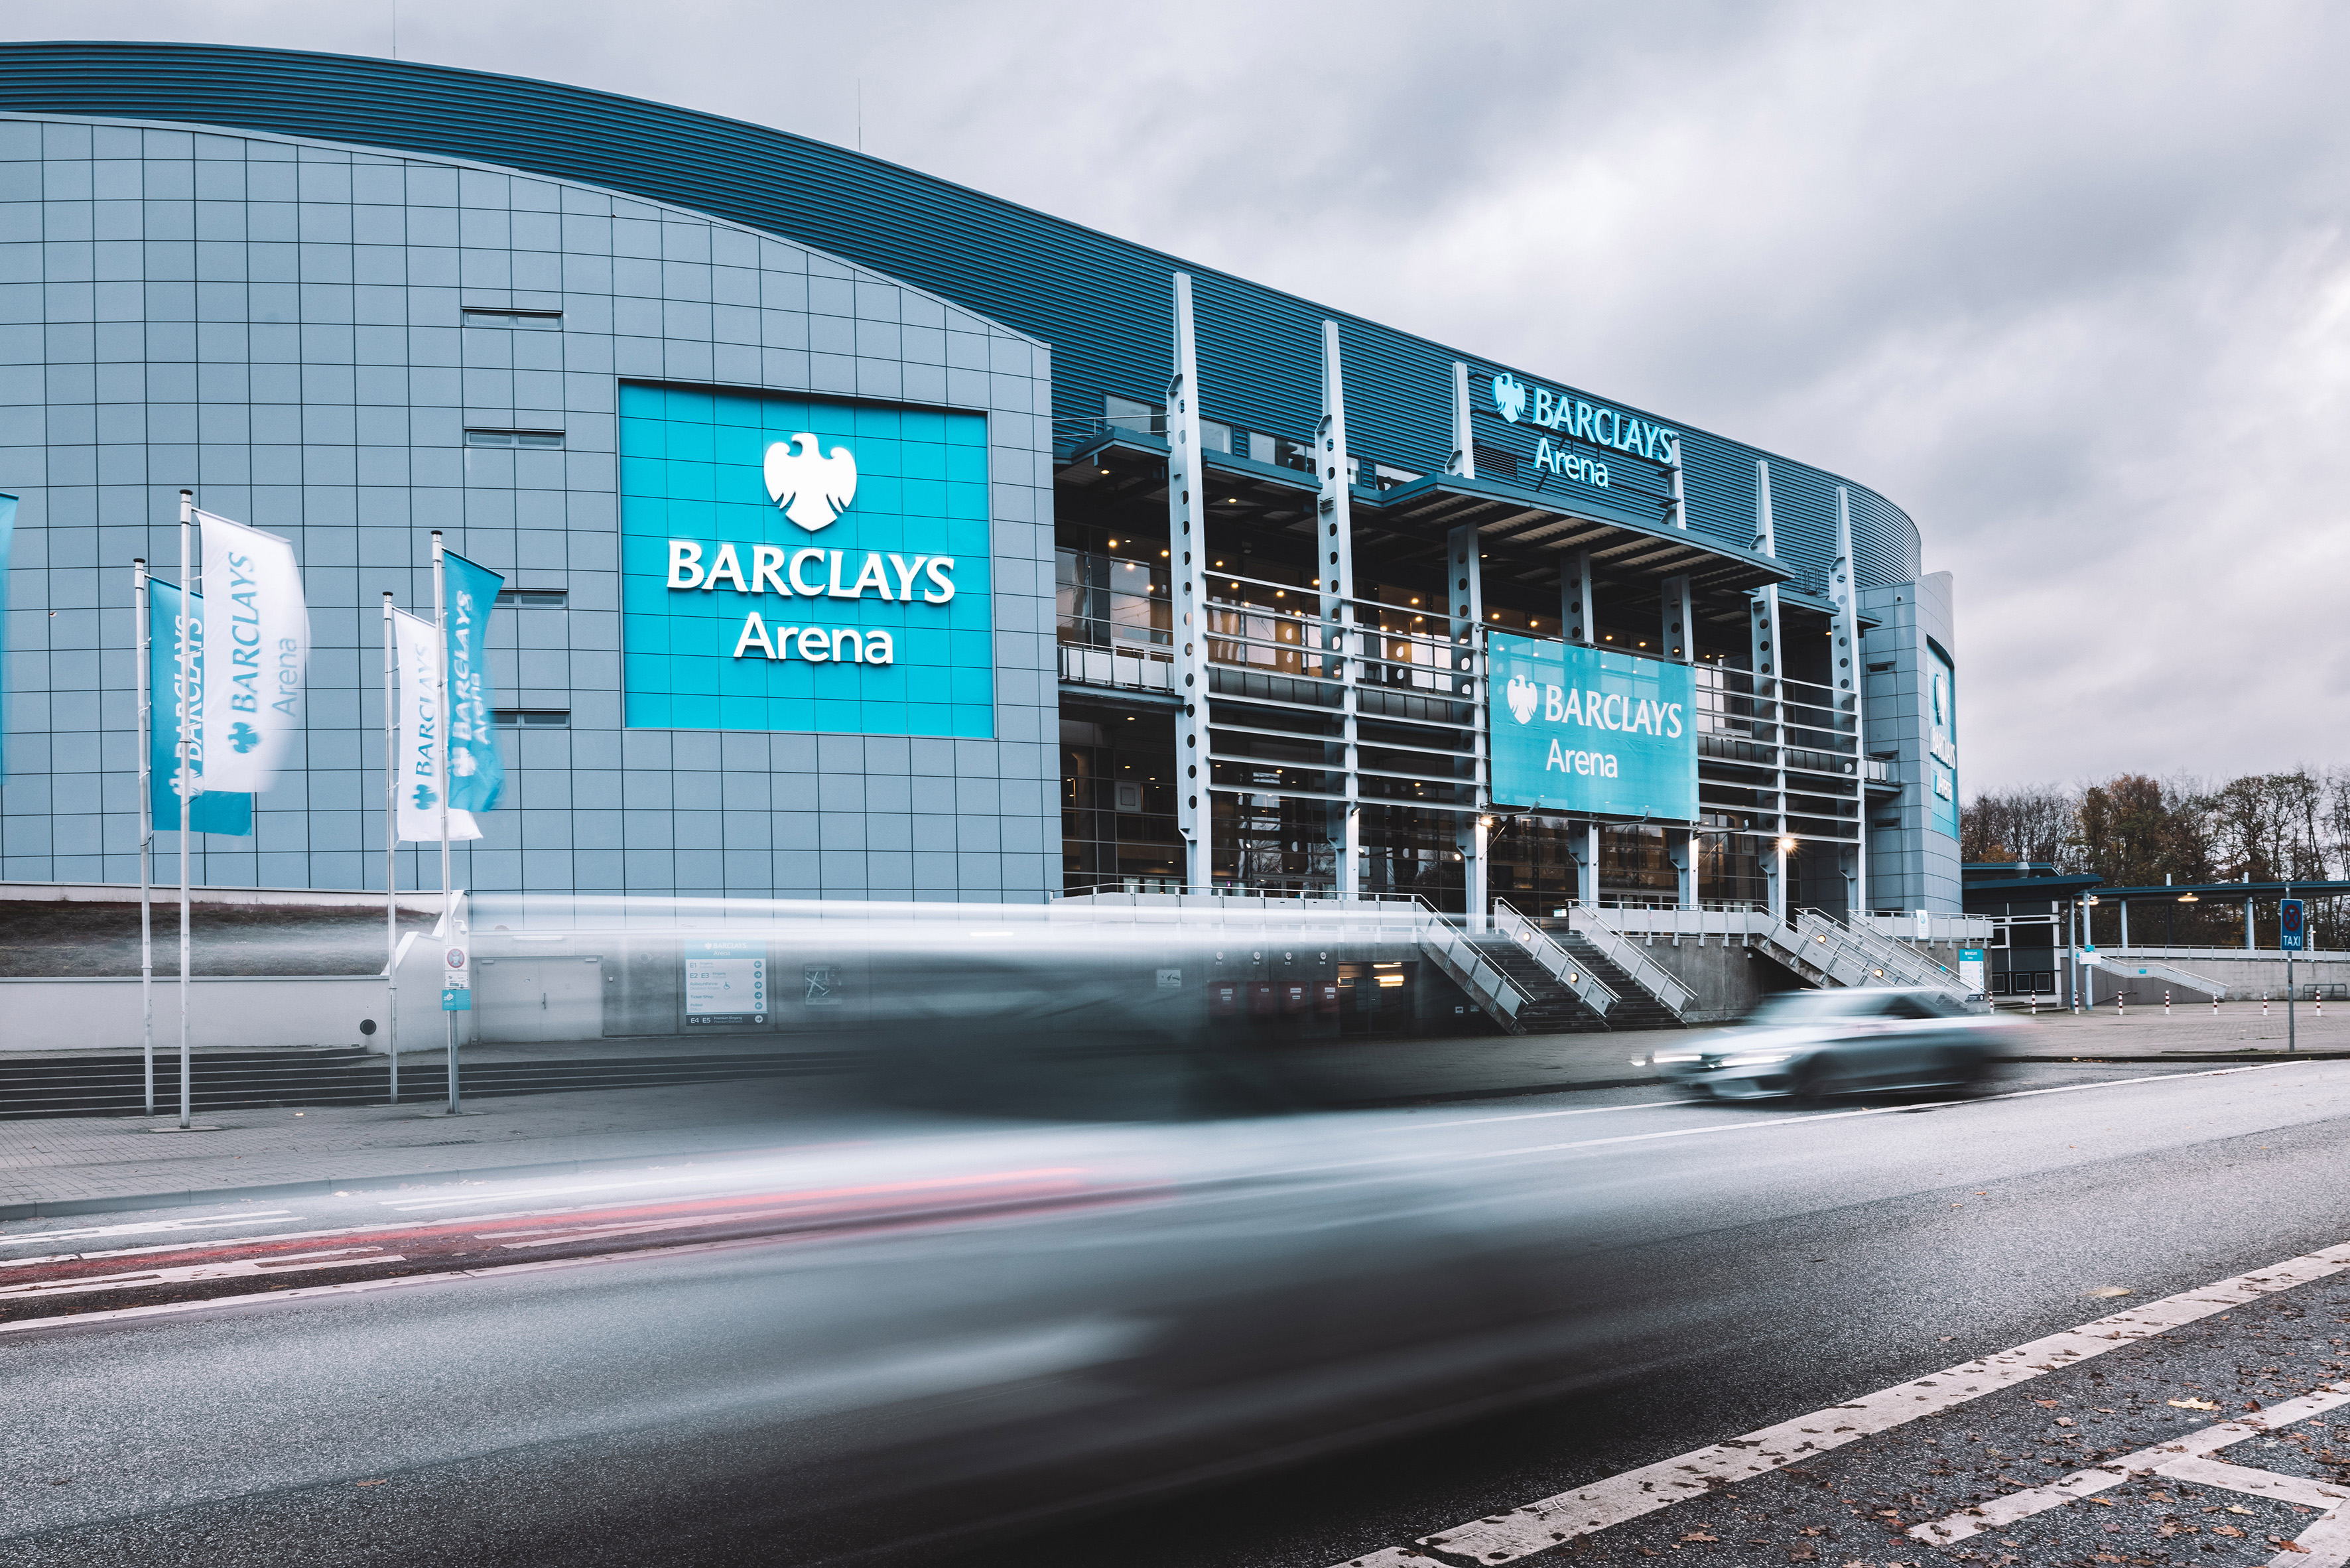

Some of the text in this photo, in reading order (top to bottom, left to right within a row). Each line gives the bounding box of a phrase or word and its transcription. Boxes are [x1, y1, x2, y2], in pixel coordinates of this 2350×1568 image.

[1532, 387, 1673, 464] BARCLAYS
[1533, 437, 1608, 488] Arena
[667, 541, 955, 604] BARCLAYS
[229, 551, 261, 713] BARCLAYS
[733, 612, 893, 664] Arena
[271, 637, 298, 718] Arena
[452, 590, 473, 741] BARCLAYS
[470, 672, 491, 745] Arena
[1545, 685, 1682, 739] BARCLAYS
[1546, 738, 1618, 778] Arena
[2283, 935, 2300, 946] TAXI
